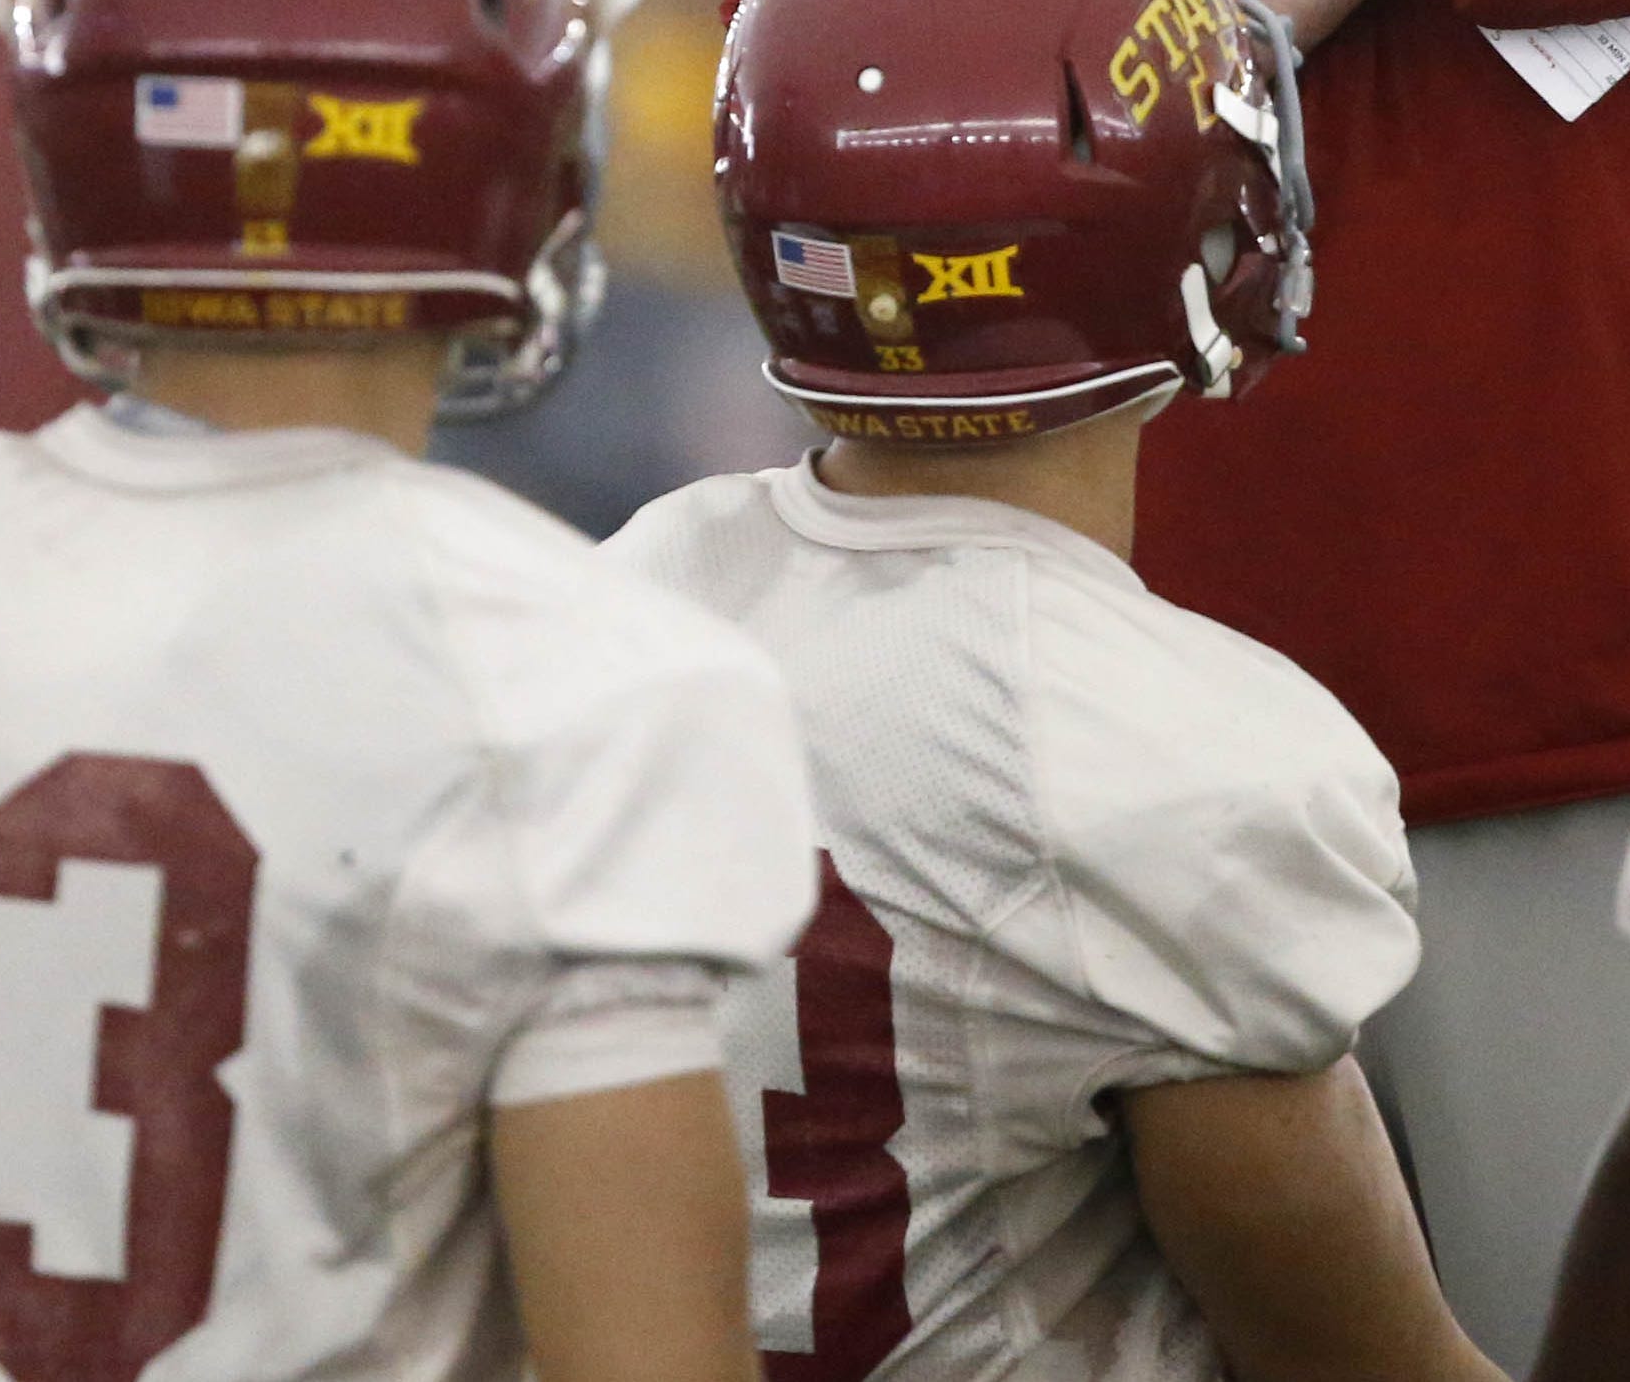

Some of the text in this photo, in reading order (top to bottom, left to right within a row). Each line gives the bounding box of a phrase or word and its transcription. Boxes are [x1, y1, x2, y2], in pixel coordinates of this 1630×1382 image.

[306, 92, 425, 165] XII
[912, 244, 1025, 304] XII
[873, 346, 925, 371] 33
[895, 410, 1035, 438] STATE
